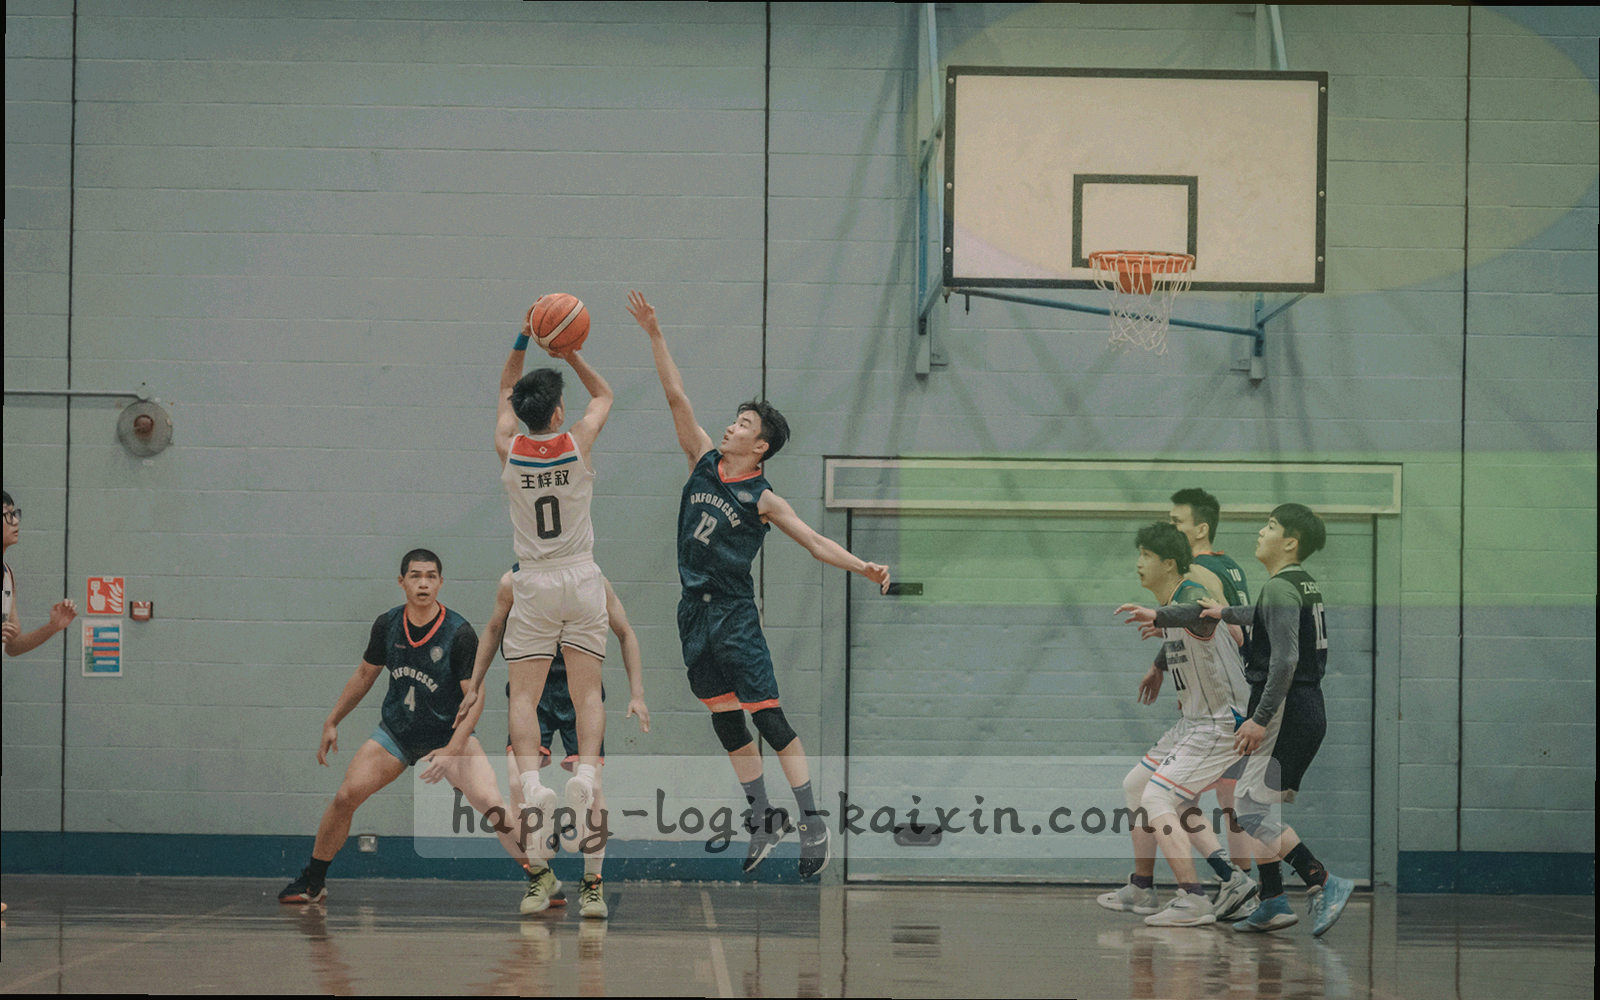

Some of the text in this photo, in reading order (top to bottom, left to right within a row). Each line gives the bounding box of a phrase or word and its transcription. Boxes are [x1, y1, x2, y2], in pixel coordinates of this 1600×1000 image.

[521, 469, 569, 489] 王梓叙
[535, 495, 562, 539] 0
[693, 511, 718, 545] 12
[1172, 667, 1187, 691] 11
[404, 685, 416, 712] 4
